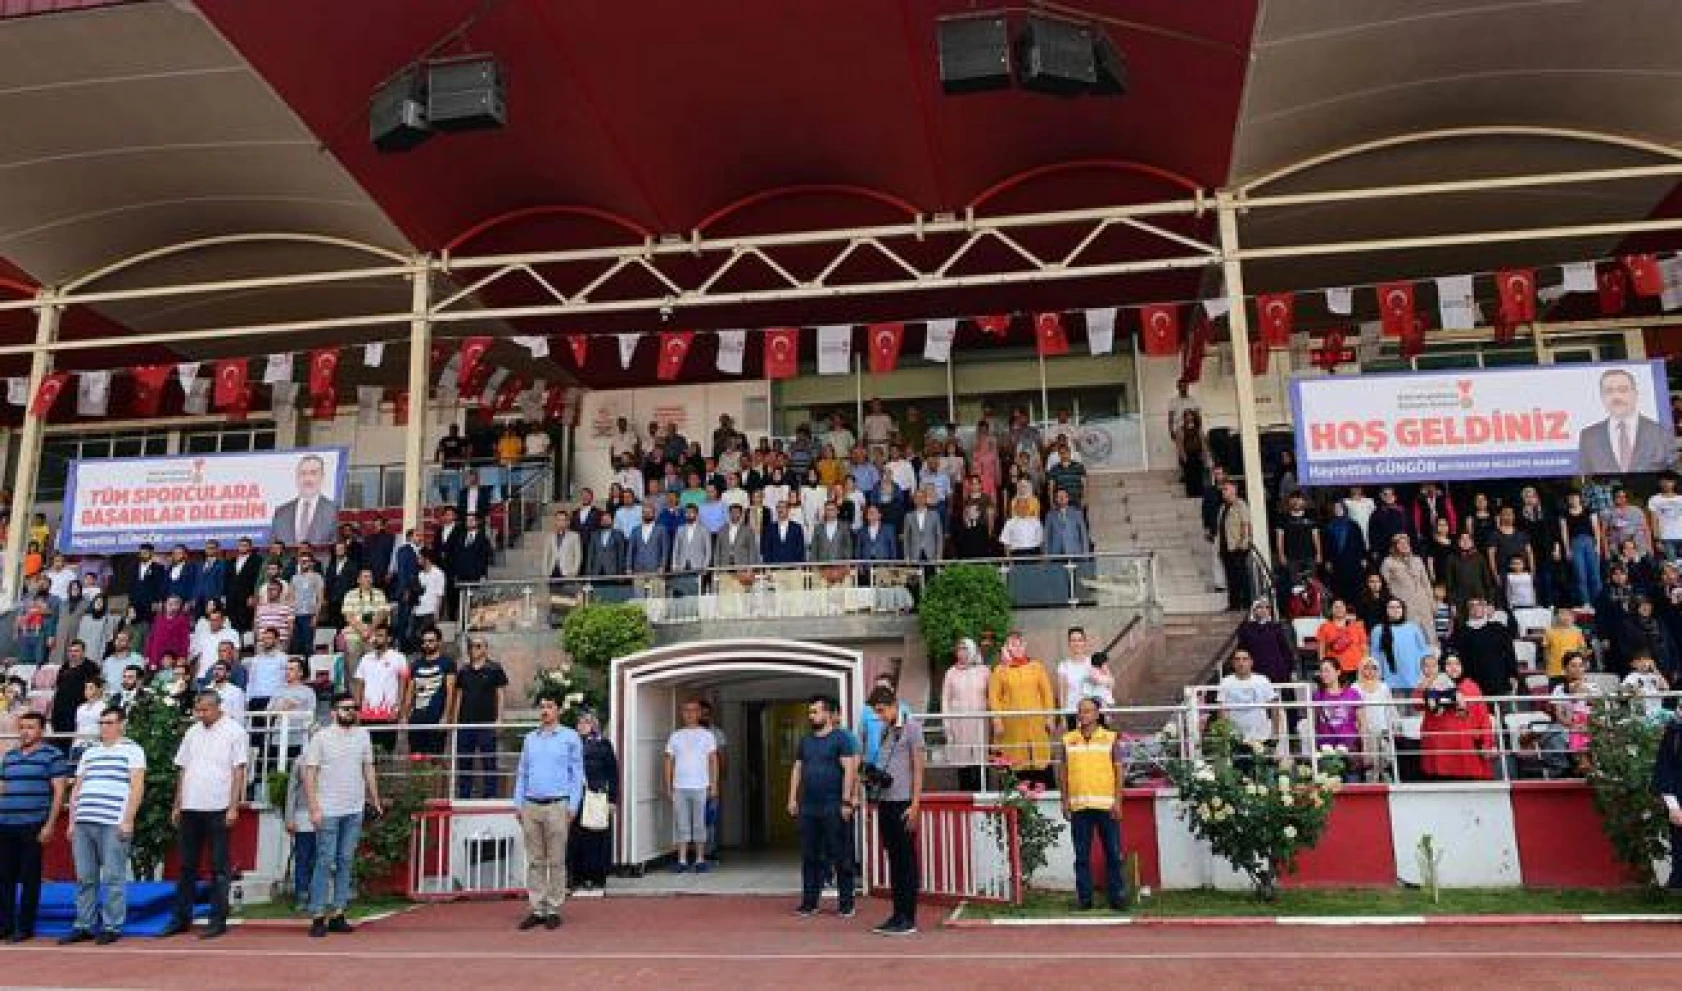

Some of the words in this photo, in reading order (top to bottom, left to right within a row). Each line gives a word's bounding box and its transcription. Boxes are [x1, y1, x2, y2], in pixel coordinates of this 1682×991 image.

[1310, 420, 1388, 453] HOŞ
[1394, 407, 1570, 446] GELDİNİZ
[91, 486, 129, 506] TÜM
[132, 484, 261, 503] SPORCULARA
[81, 505, 186, 526] BAŞARILAR
[189, 500, 268, 521] DİLERİM
